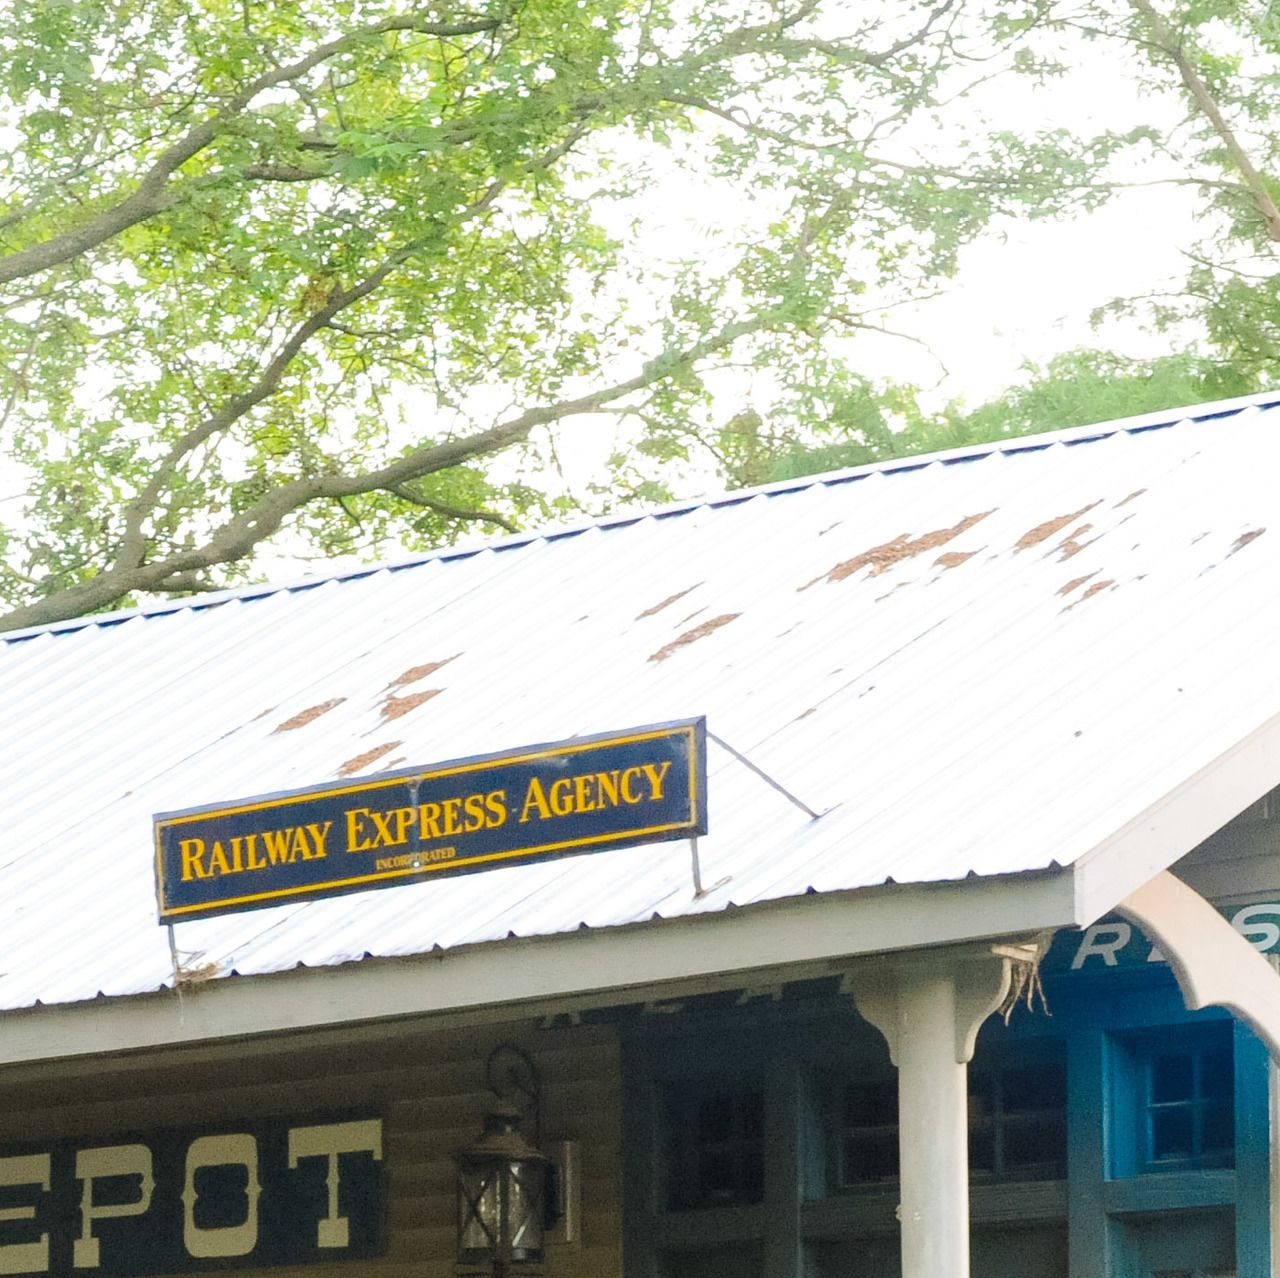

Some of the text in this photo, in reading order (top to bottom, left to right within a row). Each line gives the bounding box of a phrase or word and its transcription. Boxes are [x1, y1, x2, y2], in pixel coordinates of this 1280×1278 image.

[180, 761, 672, 882] RAILWAY EXPRESS AGENCY
